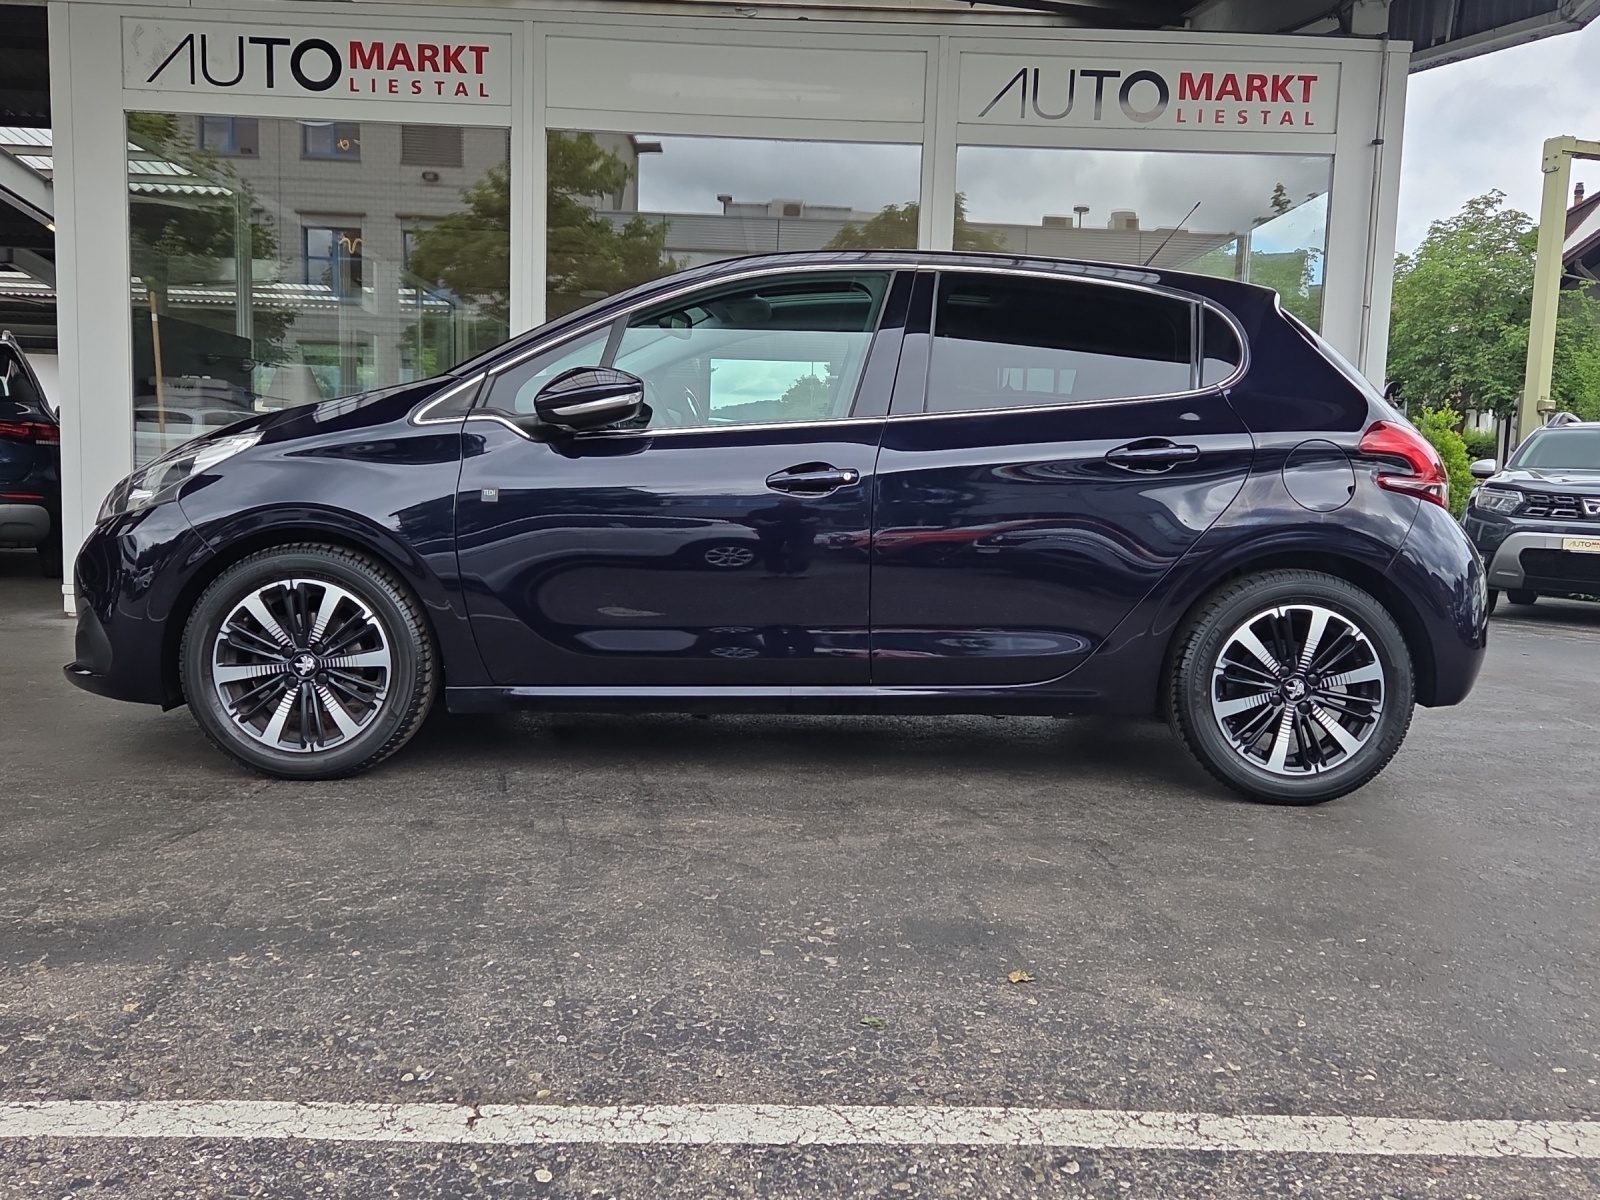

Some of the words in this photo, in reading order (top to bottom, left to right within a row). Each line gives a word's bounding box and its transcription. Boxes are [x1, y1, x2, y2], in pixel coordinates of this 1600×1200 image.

[146, 33, 342, 92] AUTO
[349, 41, 490, 75] MARKT
[349, 78, 490, 98] LIESTAL
[977, 67, 1170, 123] AUTO
[1178, 71, 1318, 104] MARKT
[1176, 108, 1315, 126] LIESTAL
[1567, 540, 1592, 548] AUTO
